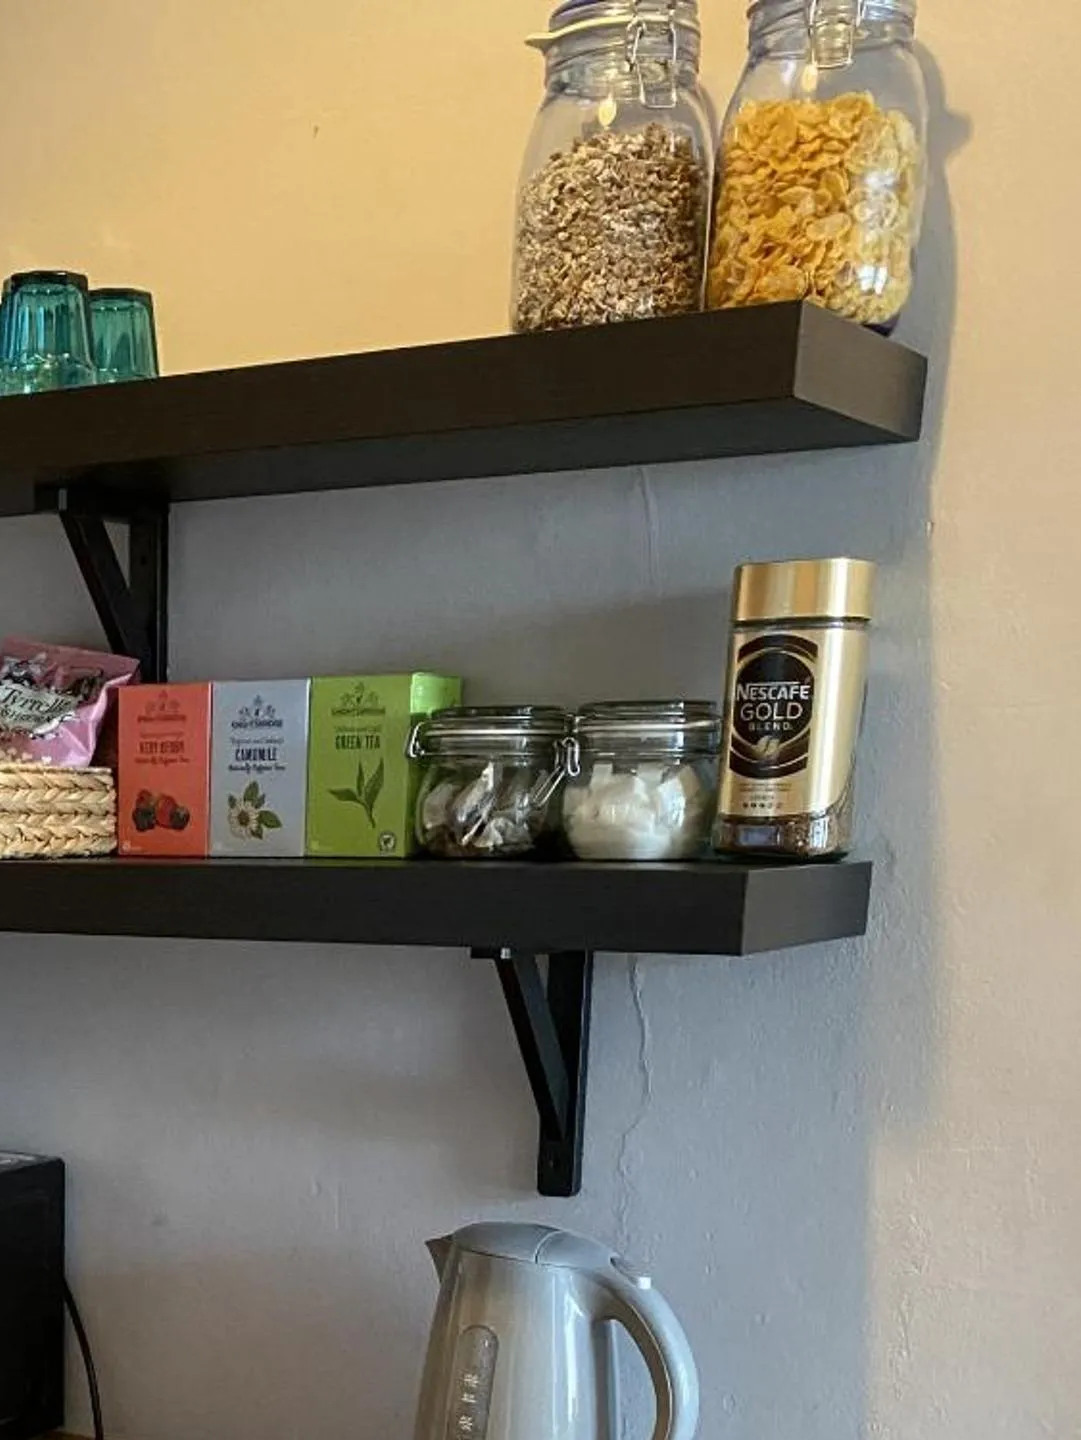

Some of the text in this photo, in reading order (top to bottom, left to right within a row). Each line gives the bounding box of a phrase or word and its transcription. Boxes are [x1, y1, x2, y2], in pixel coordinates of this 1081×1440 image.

[740, 702, 803, 721] GOLD
[748, 722, 791, 731] BLEND
[335, 735, 381, 750] GREEN TEA
